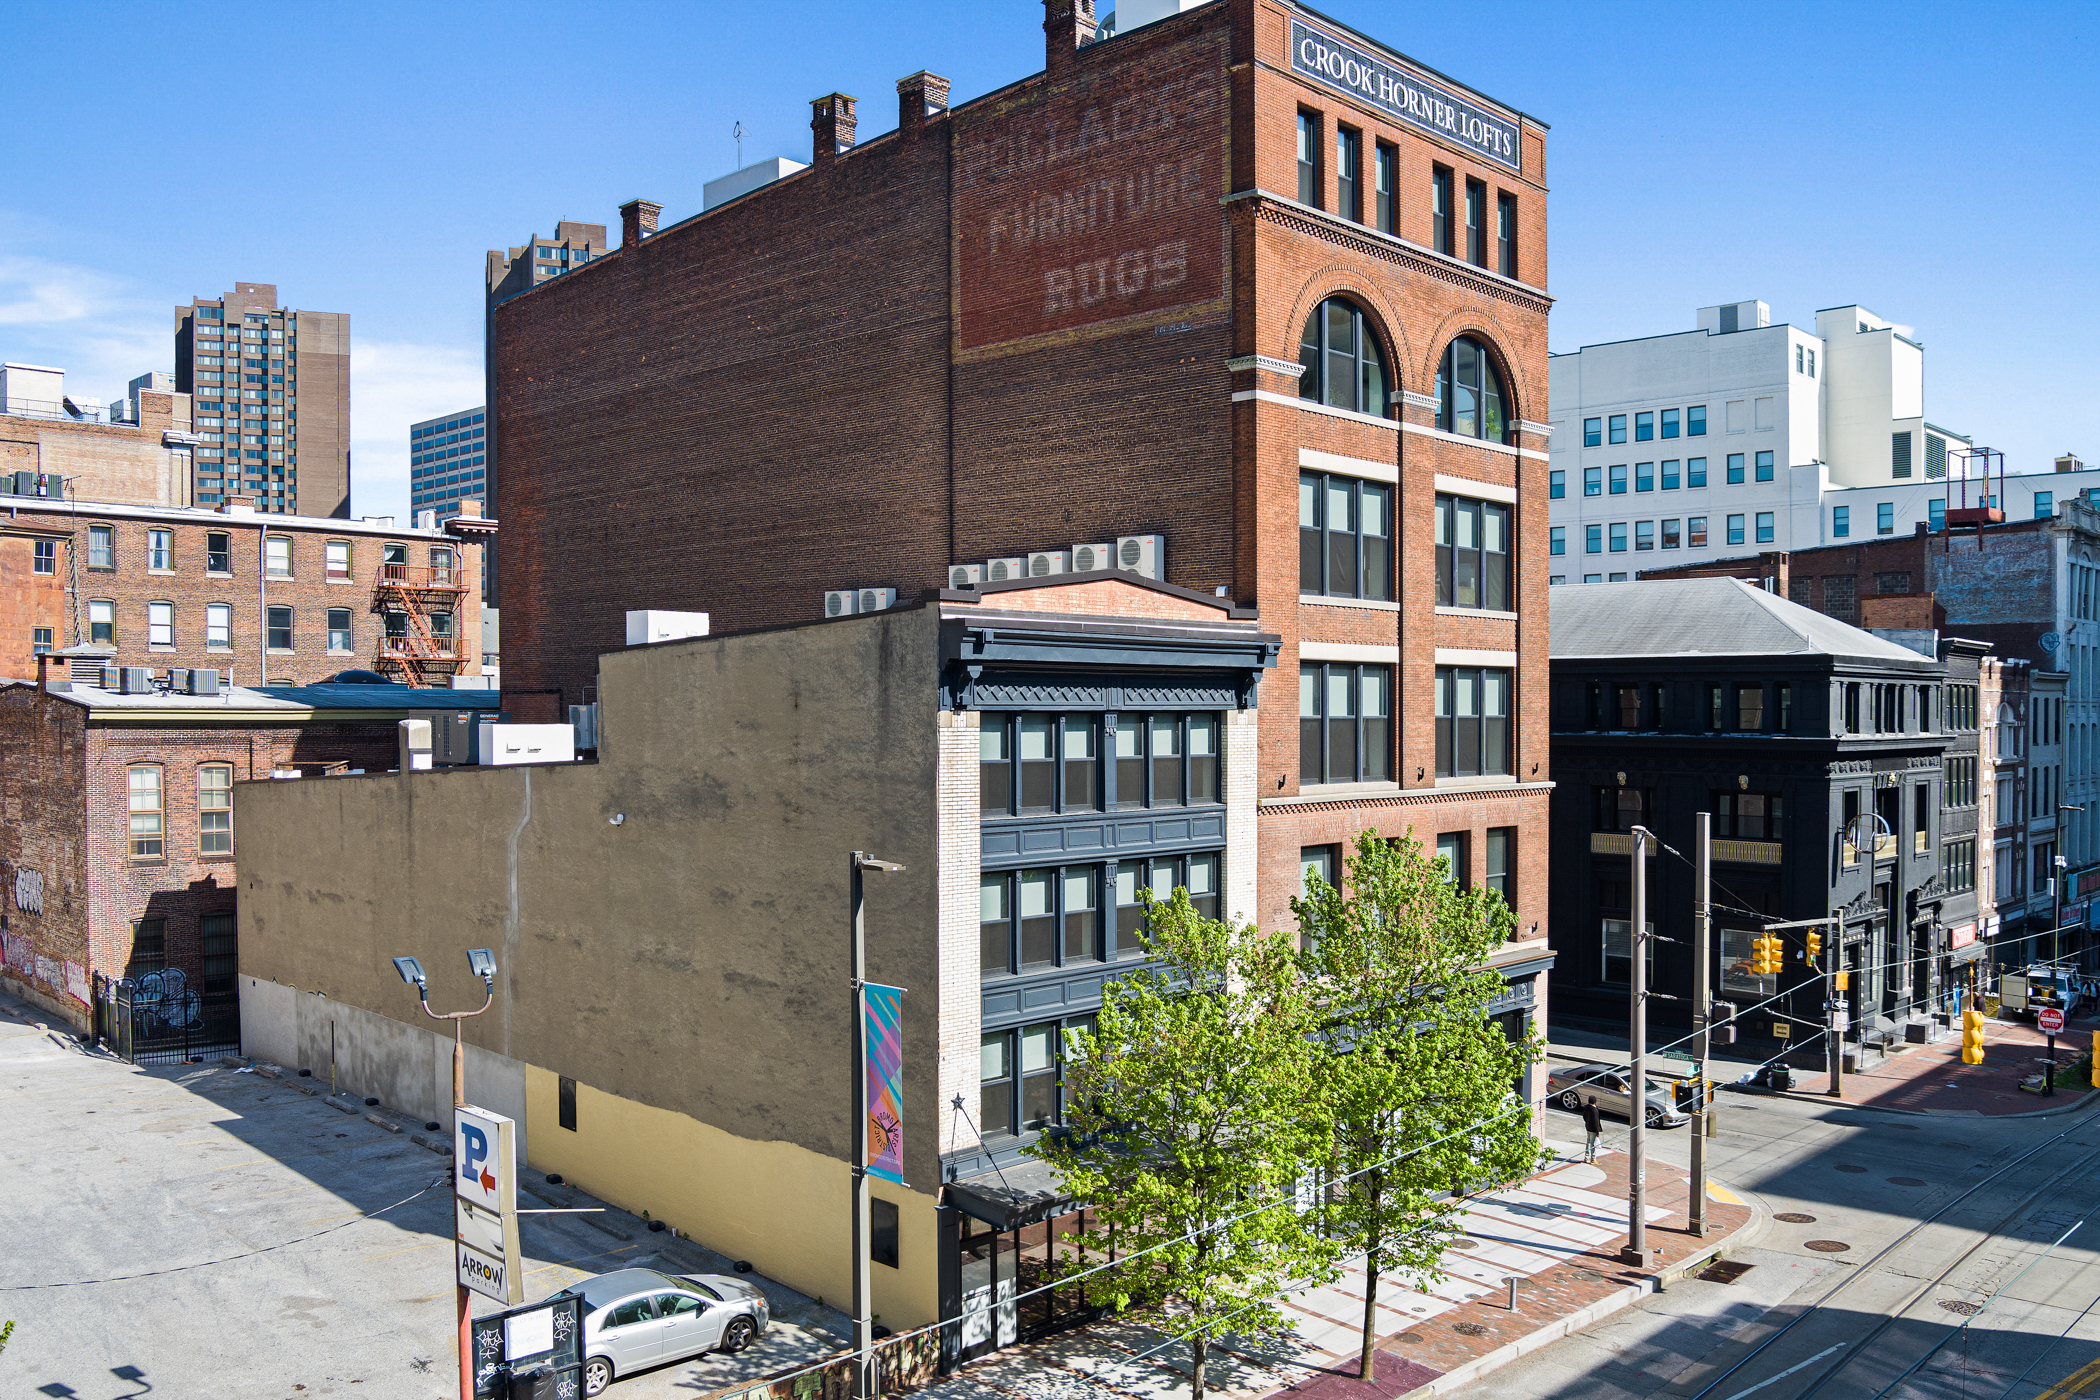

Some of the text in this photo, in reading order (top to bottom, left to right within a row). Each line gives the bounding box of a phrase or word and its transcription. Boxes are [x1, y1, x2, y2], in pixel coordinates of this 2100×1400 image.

[1300, 38, 1511, 156] CROOK HORNER LOFTS
[989, 150, 1205, 253] FURNITURE
[1043, 239, 1188, 319] RUGS
[461, 1121, 488, 1183] P
[874, 1111, 900, 1152] BROMO ARTS DISTRICT
[462, 1250, 504, 1292] ARROW
[471, 1276, 500, 1295] parking
